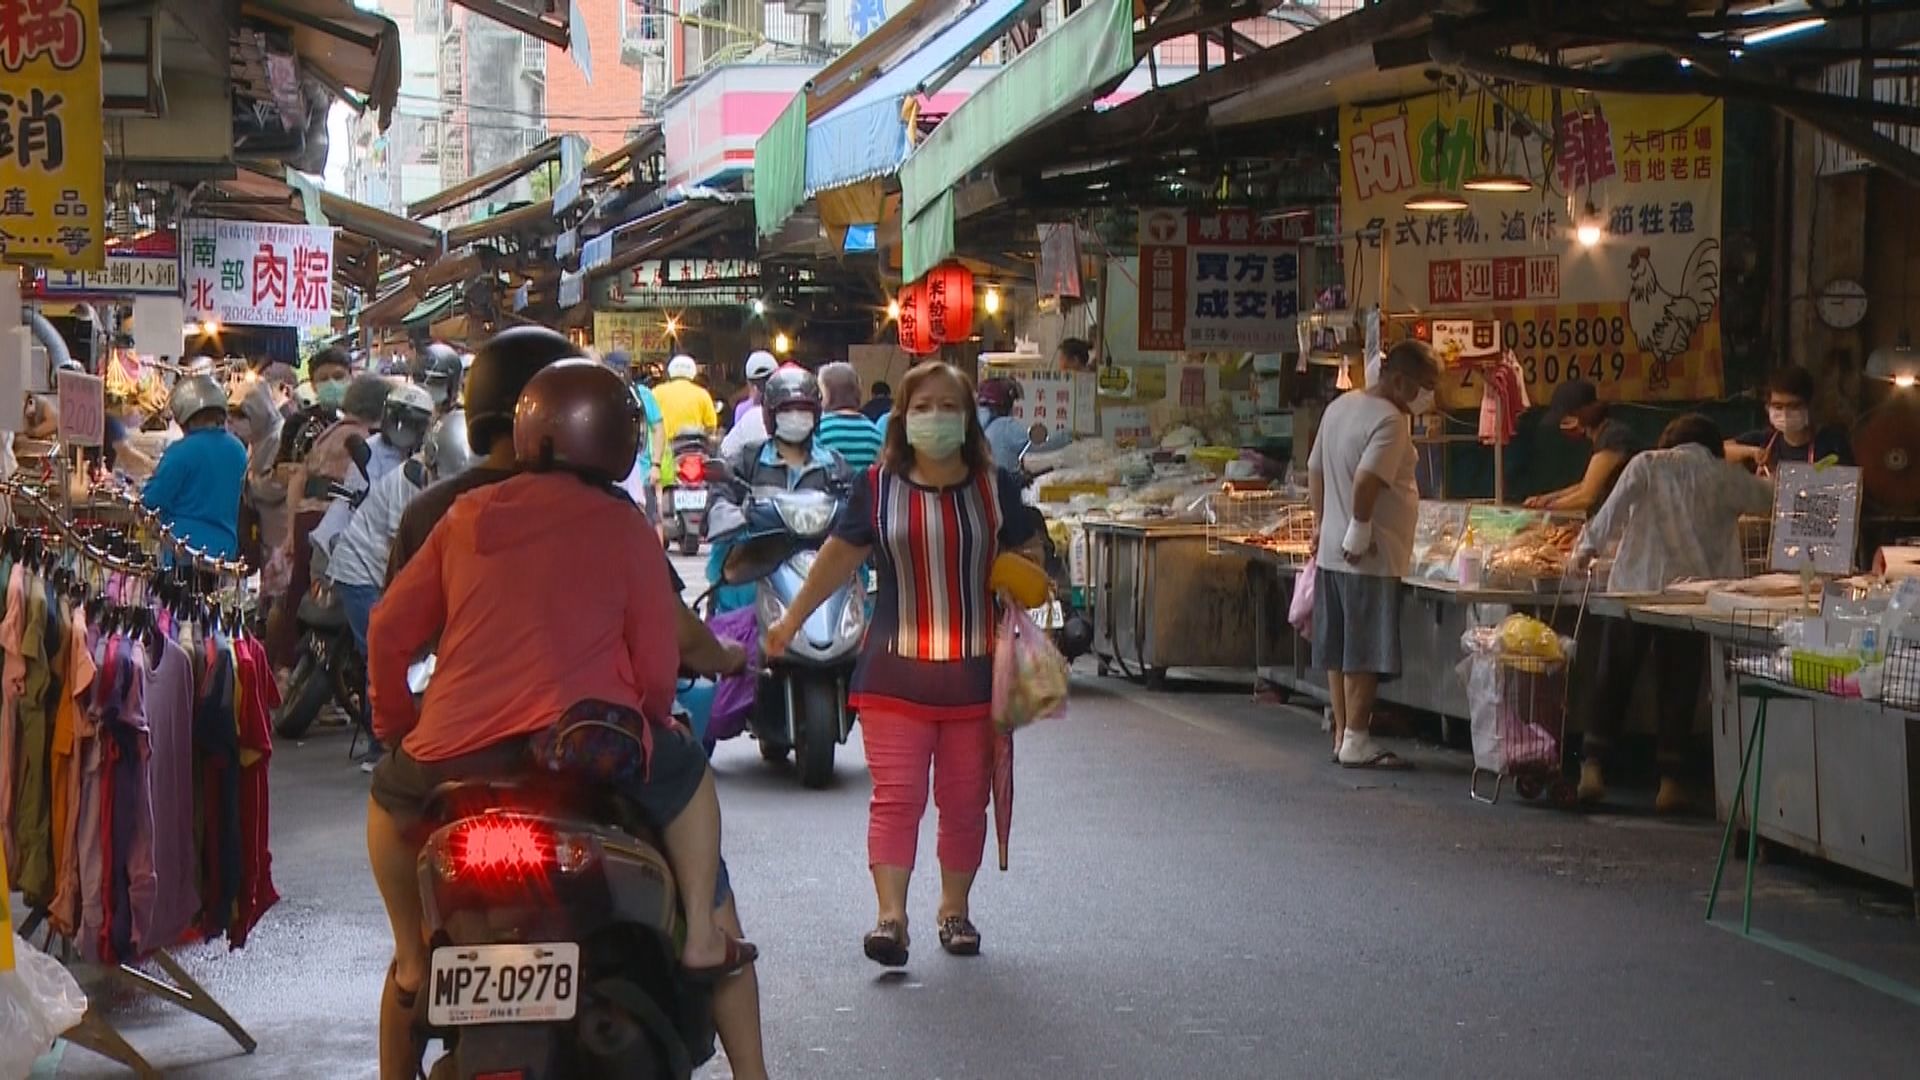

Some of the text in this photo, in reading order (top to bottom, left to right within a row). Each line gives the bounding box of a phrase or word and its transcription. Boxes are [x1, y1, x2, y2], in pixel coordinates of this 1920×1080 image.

[1623, 126, 1712, 154] 大同市場
[1624, 156, 1712, 183] 道地老店
[1432, 259, 1557, 298] 歡迎訂購
